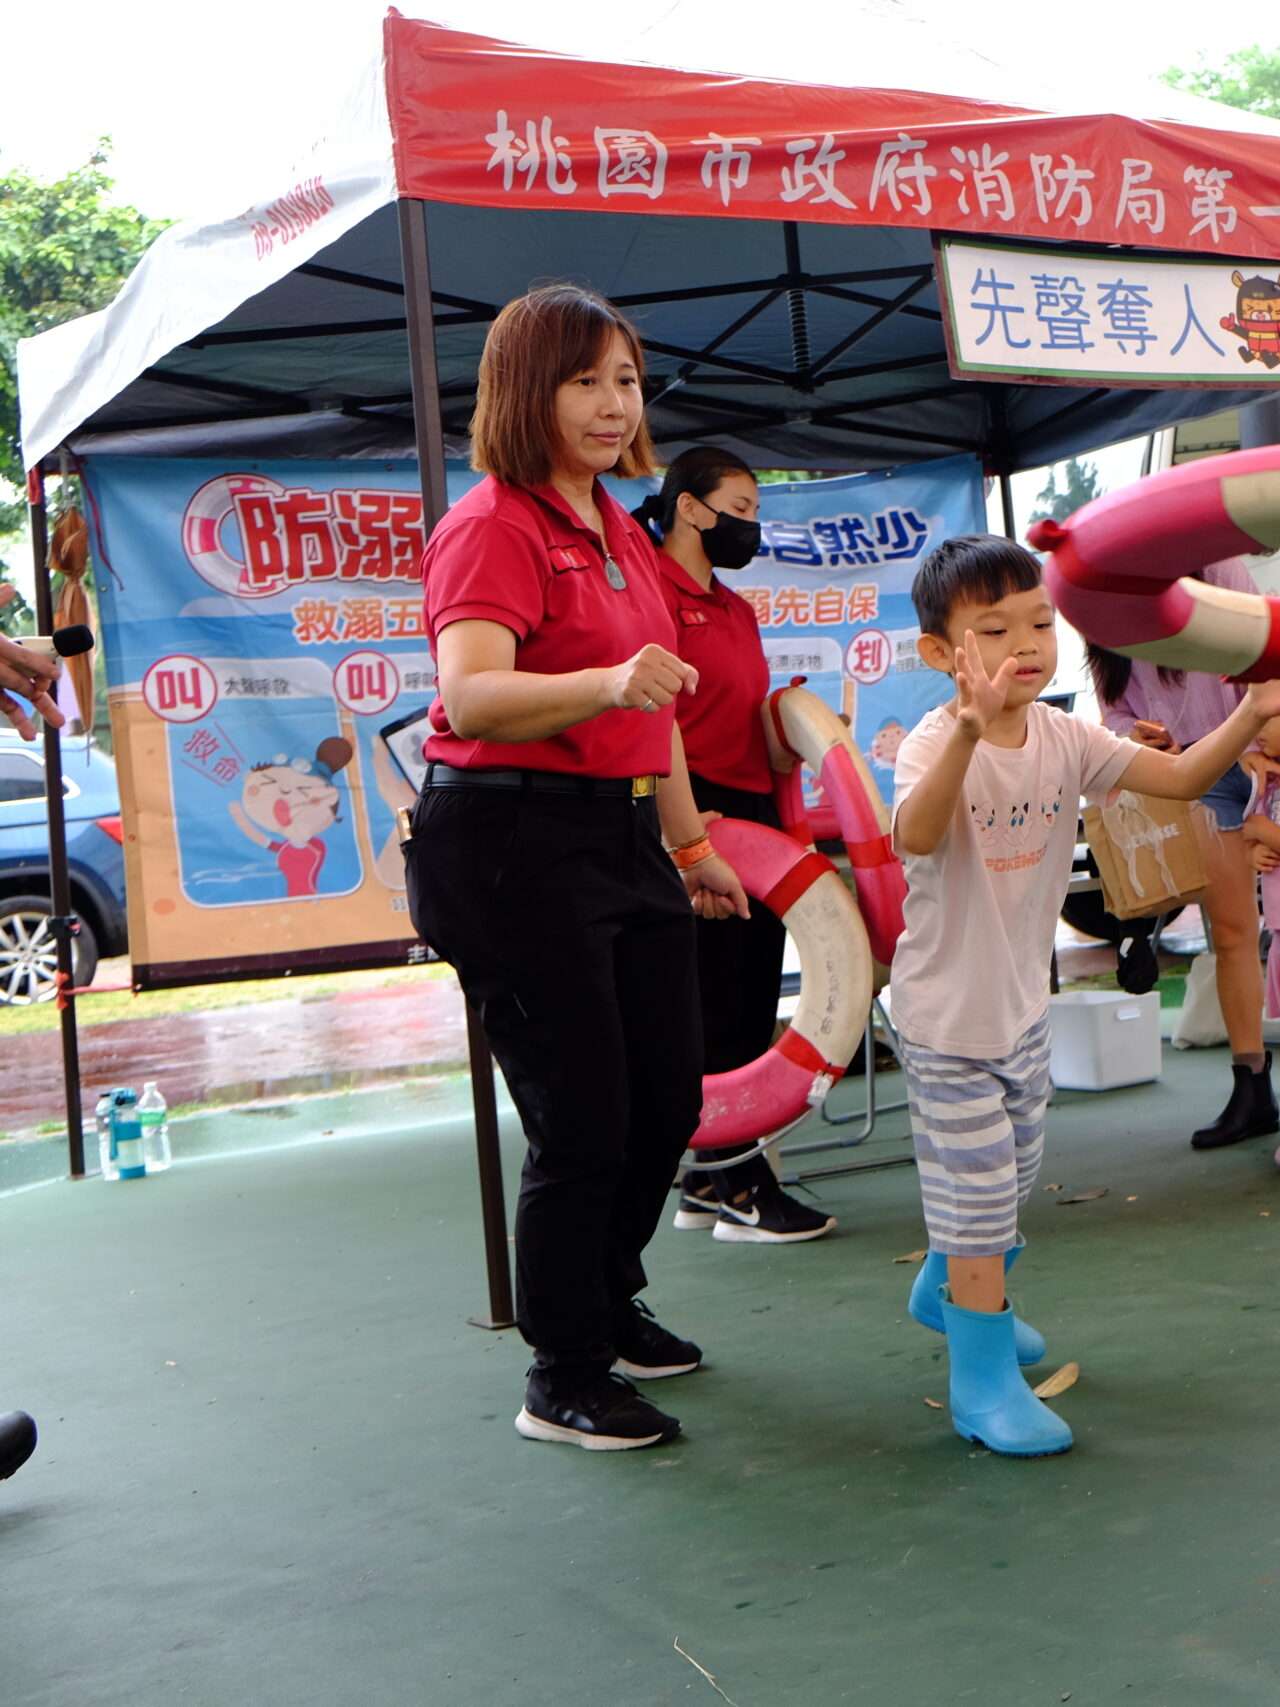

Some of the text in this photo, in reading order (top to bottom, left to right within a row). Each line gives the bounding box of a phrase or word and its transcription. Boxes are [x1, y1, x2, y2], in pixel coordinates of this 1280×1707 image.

[969, 267, 1226, 358] 先聲奪人
[234, 489, 426, 587] 防溺
[758, 508, 929, 568] 自然少
[293, 599, 427, 644] 救溺五
[854, 639, 883, 674] 划
[156, 667, 202, 711] 叫
[346, 661, 388, 701] 叫
